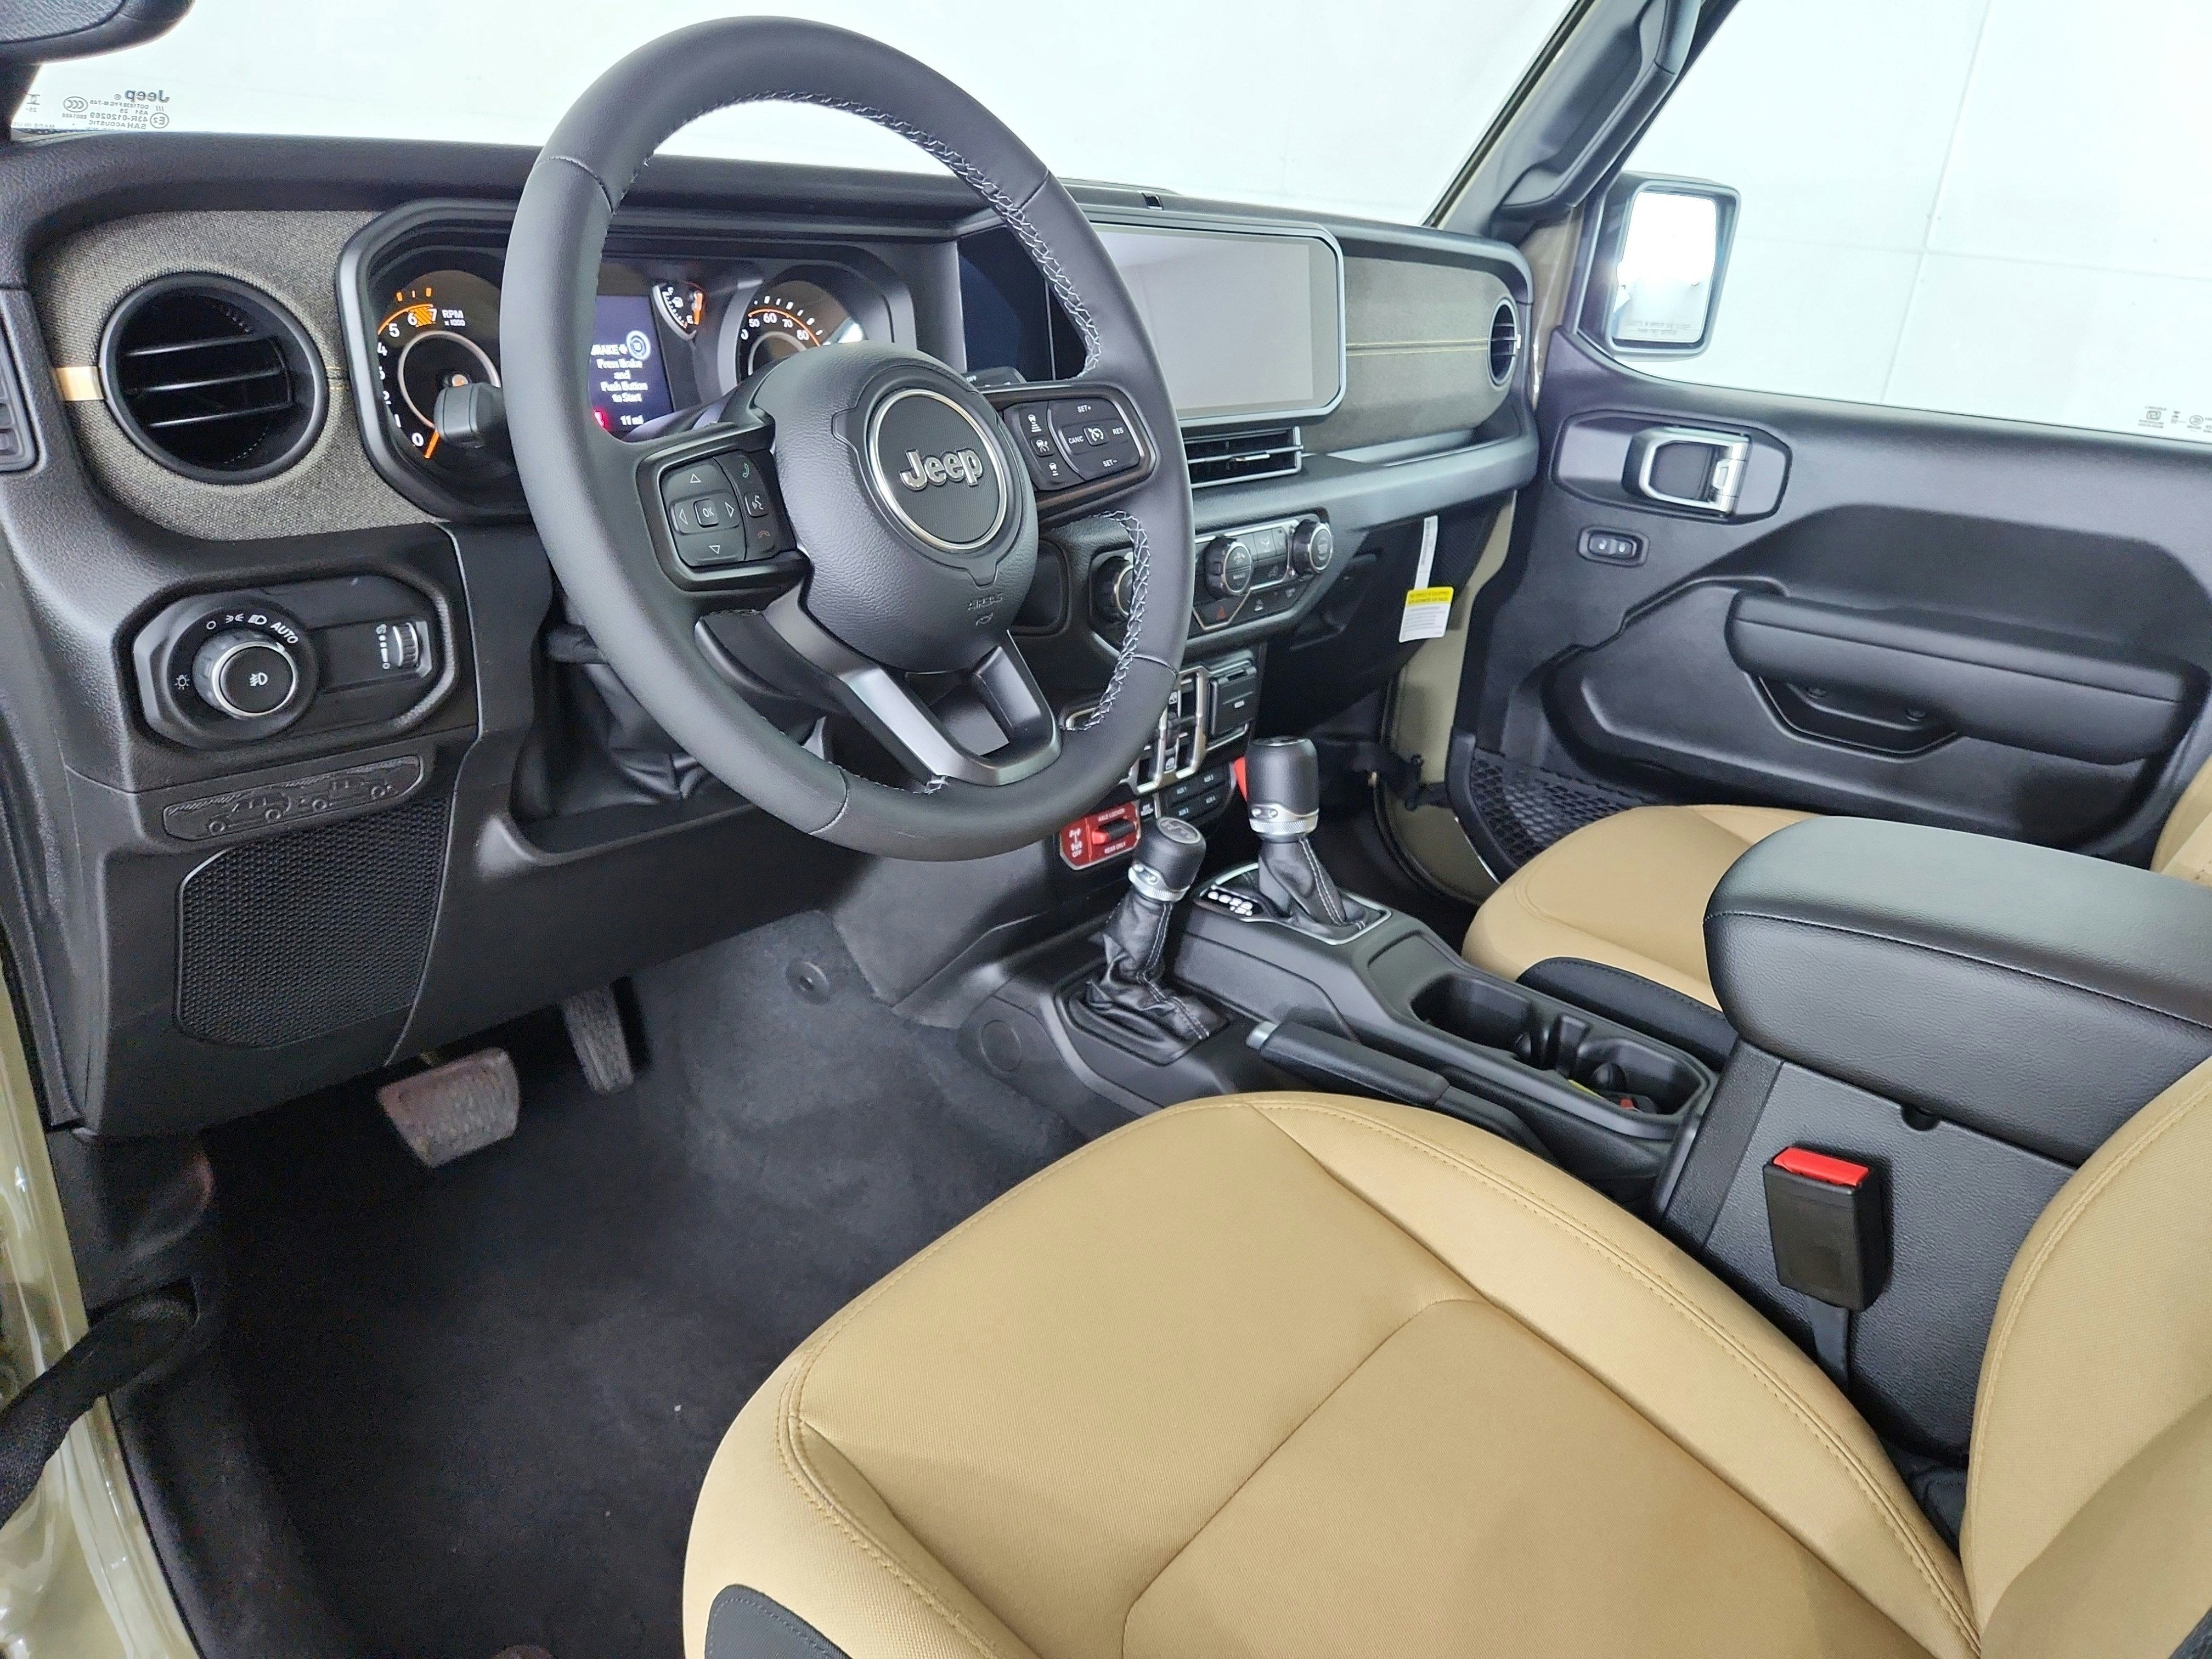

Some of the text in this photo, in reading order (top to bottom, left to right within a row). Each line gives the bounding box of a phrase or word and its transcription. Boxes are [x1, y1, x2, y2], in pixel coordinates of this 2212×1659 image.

[408, 312, 418, 326] 6
[428, 308, 437, 322] 7
[442, 309, 464, 319] RPM
[686, 315, 694, 324] E
[763, 312, 777, 323] 60
[748, 318, 760, 328] 50
[782, 319, 793, 328] 70
[388, 323, 400, 338] 5
[797, 329, 810, 341] 80
[377, 342, 388, 356] 4
[596, 358, 642, 369] Press Brake
[613, 370, 630, 380] and
[601, 381, 648, 392] Push Button
[612, 392, 642, 403] to Start
[394, 414, 402, 428] 1
[620, 415, 631, 425] 11
[1113, 427, 1124, 436] RES
[411, 432, 424, 447] 0
[1068, 436, 1084, 444] CANC
[899, 448, 983, 492] Jeep
[702, 507, 715, 518] OK
[270, 622, 298, 644] AUTO
